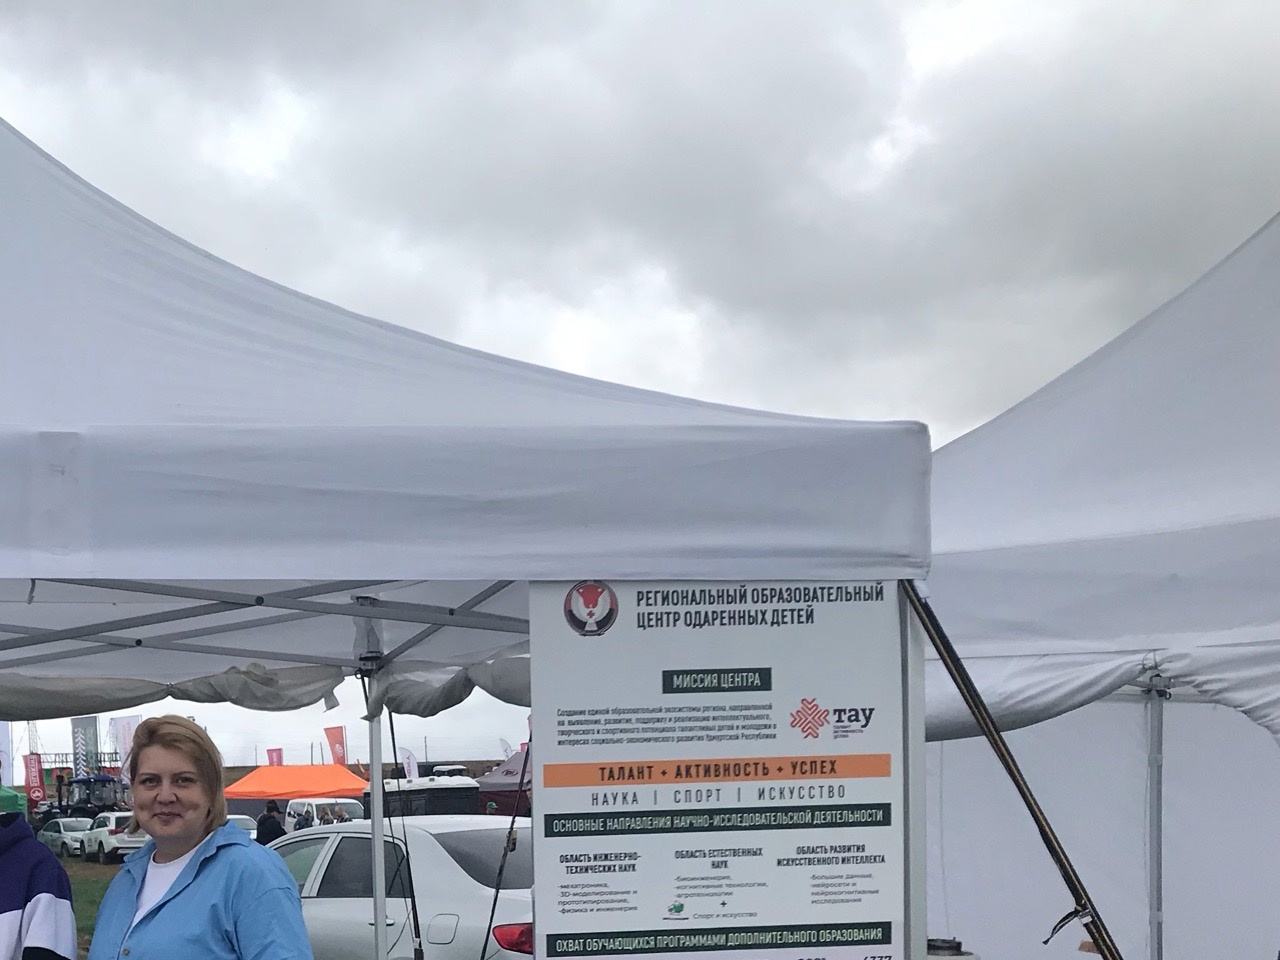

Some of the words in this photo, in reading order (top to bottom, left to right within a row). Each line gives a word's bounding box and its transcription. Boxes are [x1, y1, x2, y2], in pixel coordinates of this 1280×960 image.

[637, 585, 748, 606] РЕГИОНАЛЬНЫЙ
[752, 581, 884, 604] ОБРАЗОВАТЕЛЬНЫЙ
[637, 611, 680, 629] ЦЕНТР
[684, 609, 768, 628] ОДАРЕННЫХ
[771, 605, 814, 627] ДЕТЕЙ
[673, 674, 718, 689] МИССИЯ
[720, 672, 761, 688] ЦЕНТРА
[833, 708, 875, 728] тау
[599, 766, 654, 781] ТАЛАНТ
[675, 762, 769, 779] АКТИВНОСТЬ
[791, 760, 837, 775] УСПЕХ
[592, 792, 639, 806] НАУКА
[674, 789, 721, 803] СПОРТ
[758, 785, 845, 800] ИСКУССТВО
[553, 819, 604, 832] ОСНОВНЫЕ
[606, 816, 671, 831] НАПРАВЛЕНИЯ
[673, 810, 812, 829] НАУЧНО-ИССЛЕДОВАТЕЛЬСКОЙ
[813, 809, 883, 825] ДЕЯТЕЛЬНОСТИ
[560, 854, 591, 863] ОБЛАСТЬ
[675, 850, 707, 859] ОБЛАСТЬ
[796, 845, 828, 855] ОБЛАСТЬ
[829, 844, 866, 854] РАЗВИТИЯ
[565, 865, 616, 874] ТЕХНИЧЕСКИХ
[618, 864, 637, 873] НАУК
[711, 860, 729, 869] НАУК
[777, 856, 840, 866] ИСКУССТВЕННОГО
[841, 855, 885, 865] ИНТЕЛЛЕКТА
[556, 939, 584, 952] ОХВАТ
[586, 936, 655, 951] ОБУЧАЮЩИХСЯ
[657, 934, 726, 948] ПРОГРАММАМИ
[727, 930, 818, 946] ДОПОЛНИТЕЛЬНОГО
[819, 928, 883, 942] ОБРАЗОВАНИЯ
